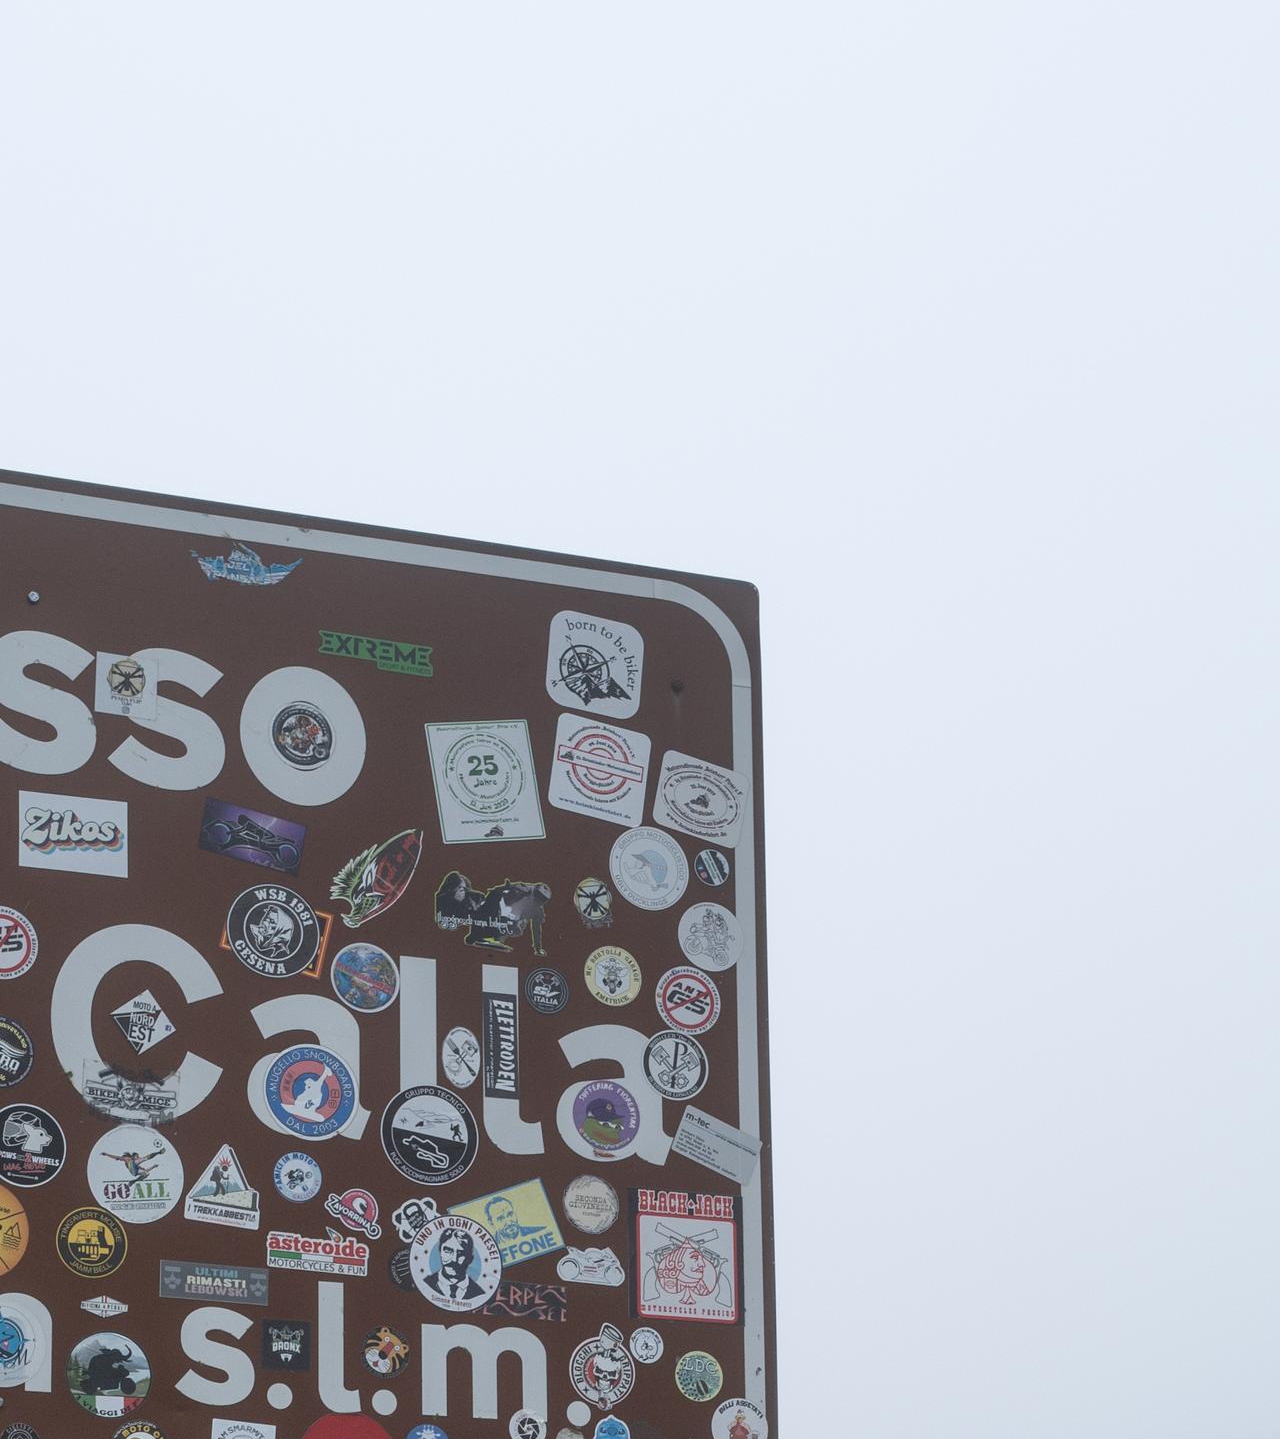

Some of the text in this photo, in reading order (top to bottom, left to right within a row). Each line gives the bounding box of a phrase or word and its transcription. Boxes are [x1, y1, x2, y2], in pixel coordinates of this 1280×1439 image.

[320, 631, 432, 667] EXTREME
[565, 618, 636, 692] born to be biker
[467, 755, 499, 778] 25
[21, 806, 120, 848] Zikos
[254, 889, 314, 927] WSB 1981
[233, 939, 287, 975] CESENA
[129, 1013, 155, 1028] NORD
[51, 923, 673, 1166] Calla
[128, 1025, 156, 1044] EST
[87, 1085, 174, 1108] BIKER MICE
[404, 1087, 467, 1115] GRUPPO TECNICO
[638, 1188, 735, 1218] BLACK JACK
[269, 1236, 368, 1259] asteroide
[195, 1266, 239, 1279] ULTIMI
[270, 1257, 367, 1276] MOTORCYCLES & FUN
[184, 1283, 249, 1299] LEBOWSKI
[186, 1275, 247, 1290] RIMASTI
[175, 1281, 591, 1427] s.l.m.
